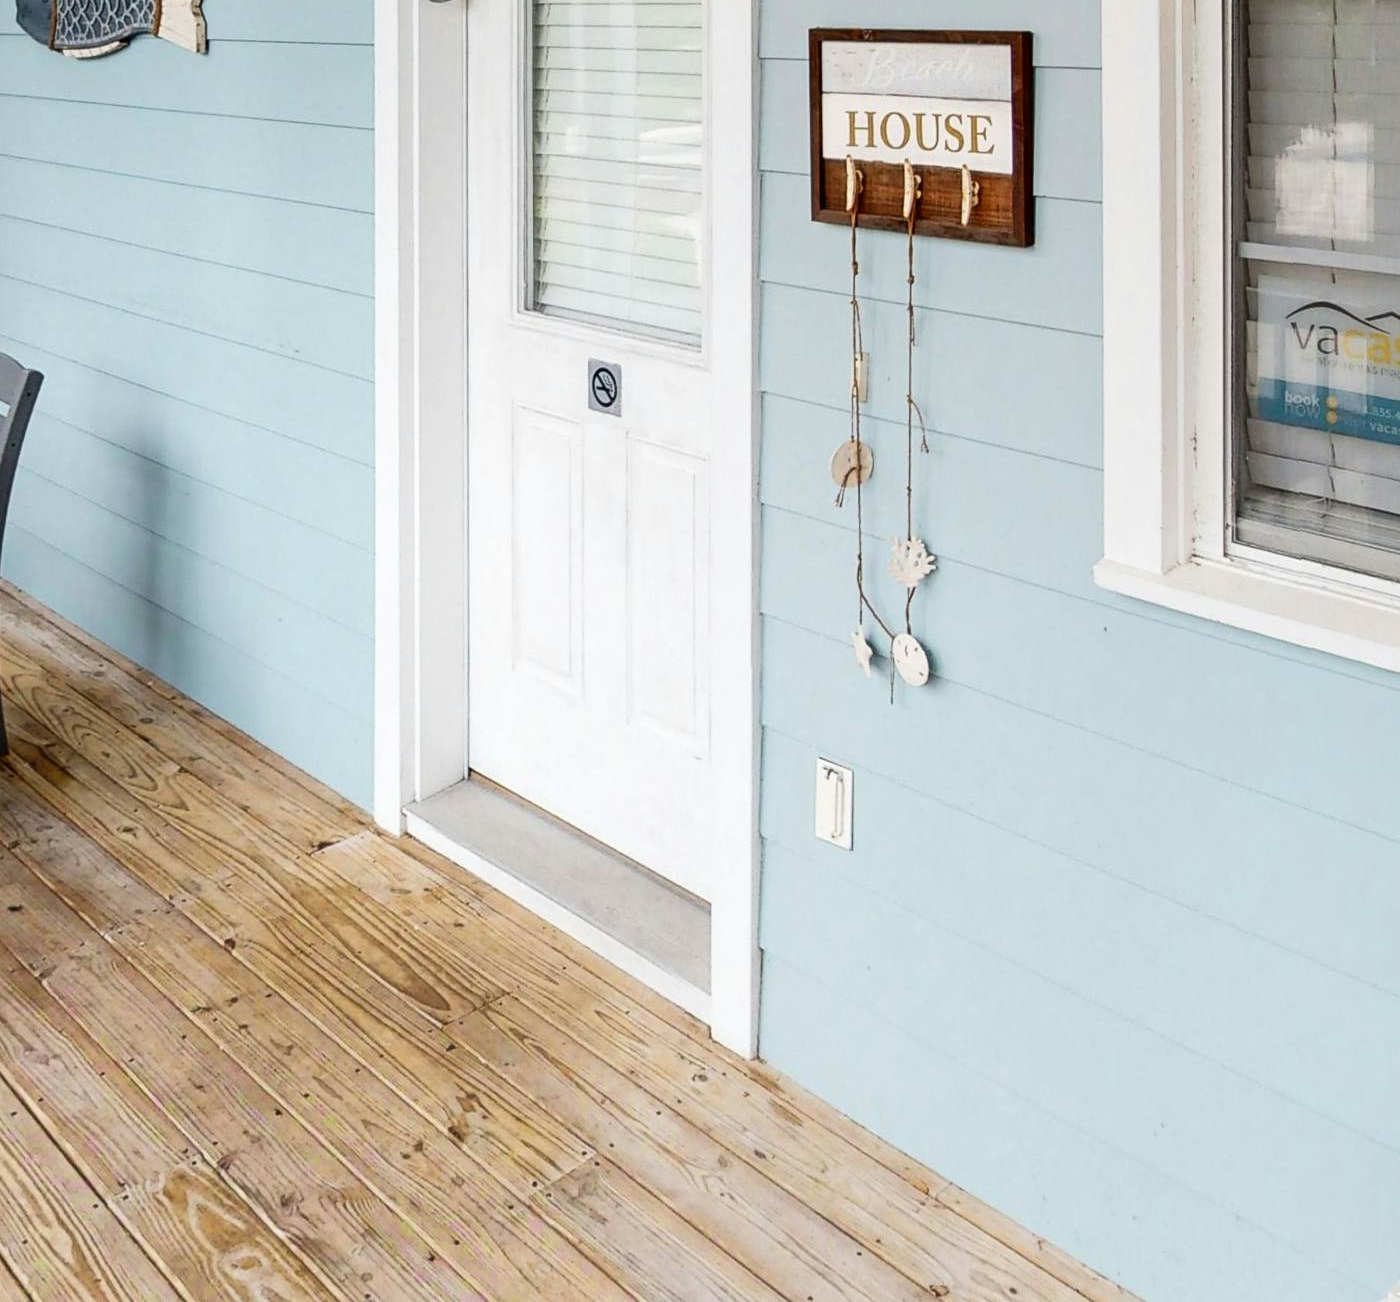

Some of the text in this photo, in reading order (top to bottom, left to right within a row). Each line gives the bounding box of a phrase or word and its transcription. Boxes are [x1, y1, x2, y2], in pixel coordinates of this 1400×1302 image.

[845, 110, 995, 154] HOUSE
[1285, 390, 1320, 407] book
[1370, 421, 1400, 436] vaca
